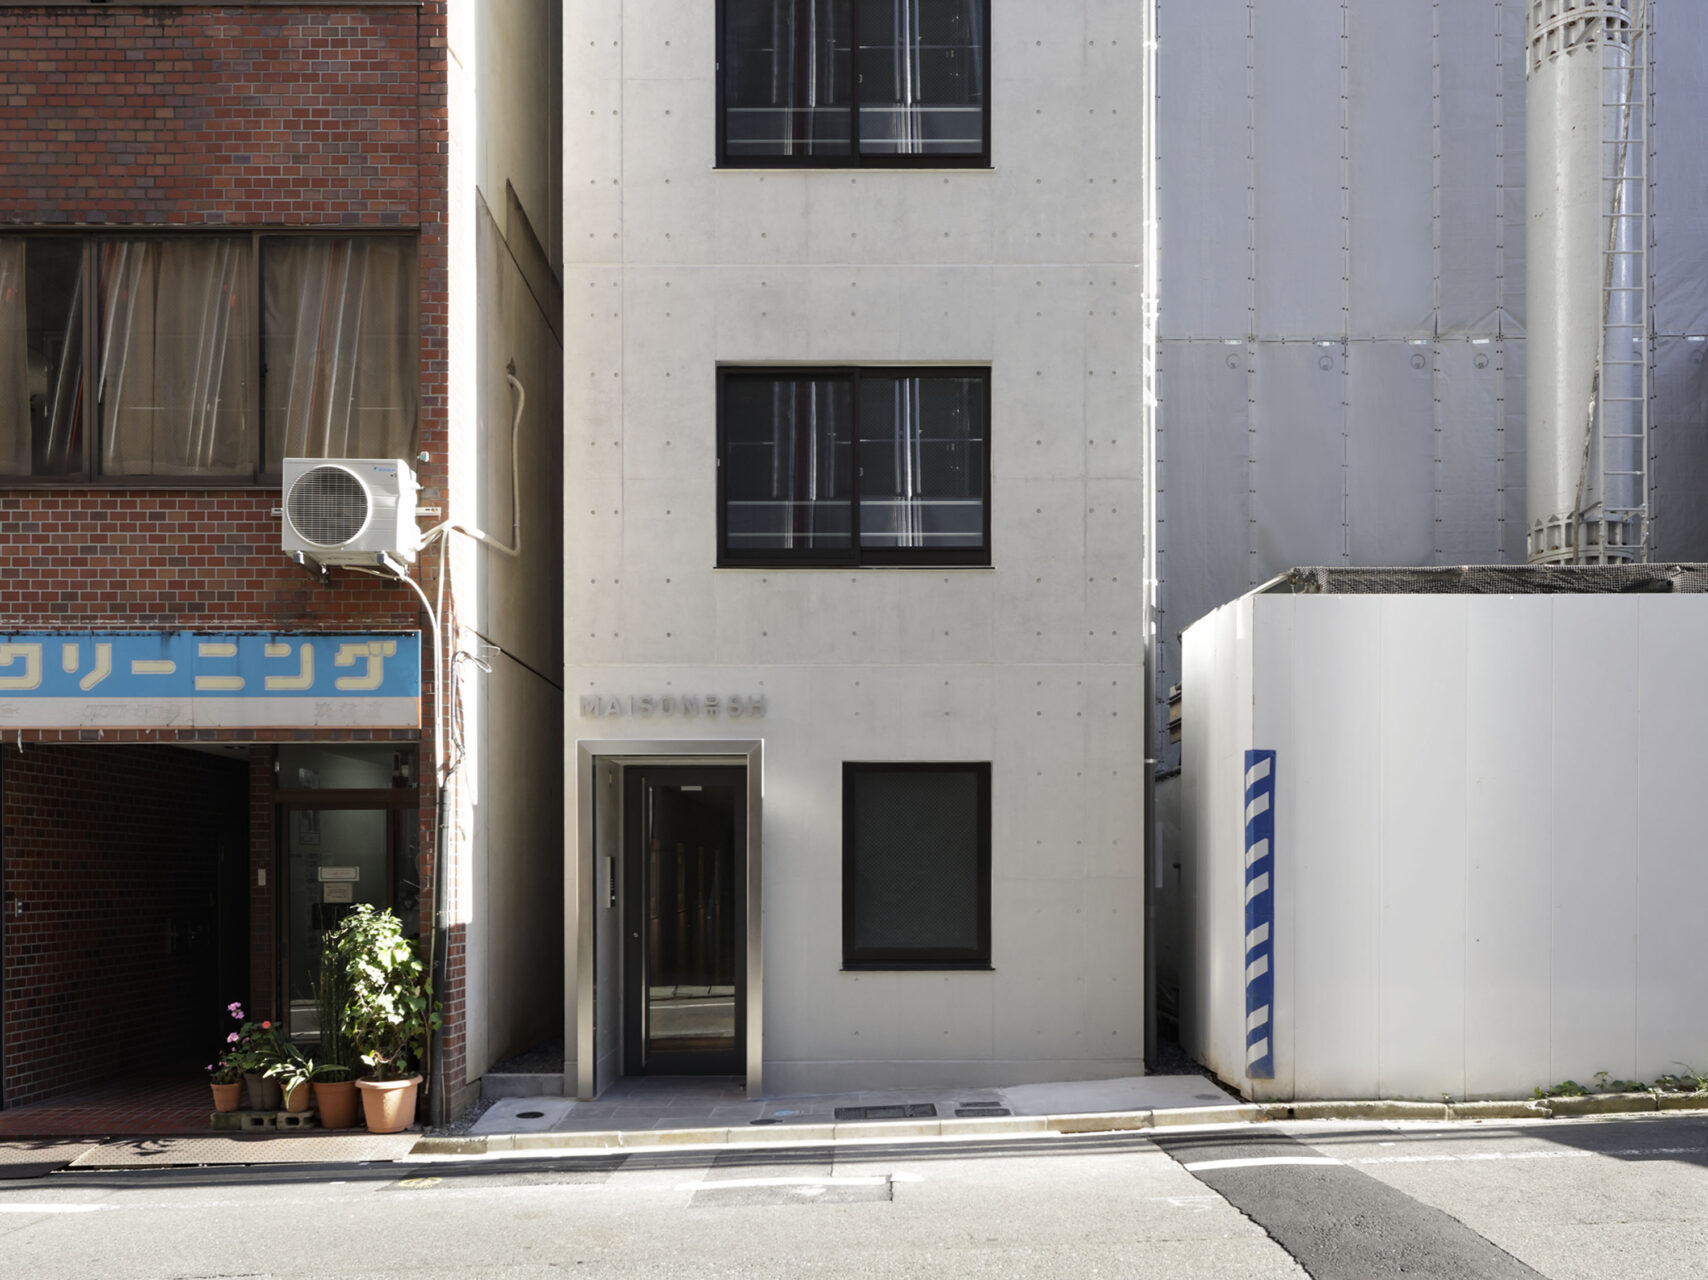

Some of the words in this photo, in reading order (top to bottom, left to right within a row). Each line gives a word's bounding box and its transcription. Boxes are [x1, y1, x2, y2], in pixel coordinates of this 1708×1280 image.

[0, 640, 397, 691] クリーニング
[579, 694, 700, 719] MAISON
[726, 694, 767, 719] SH
